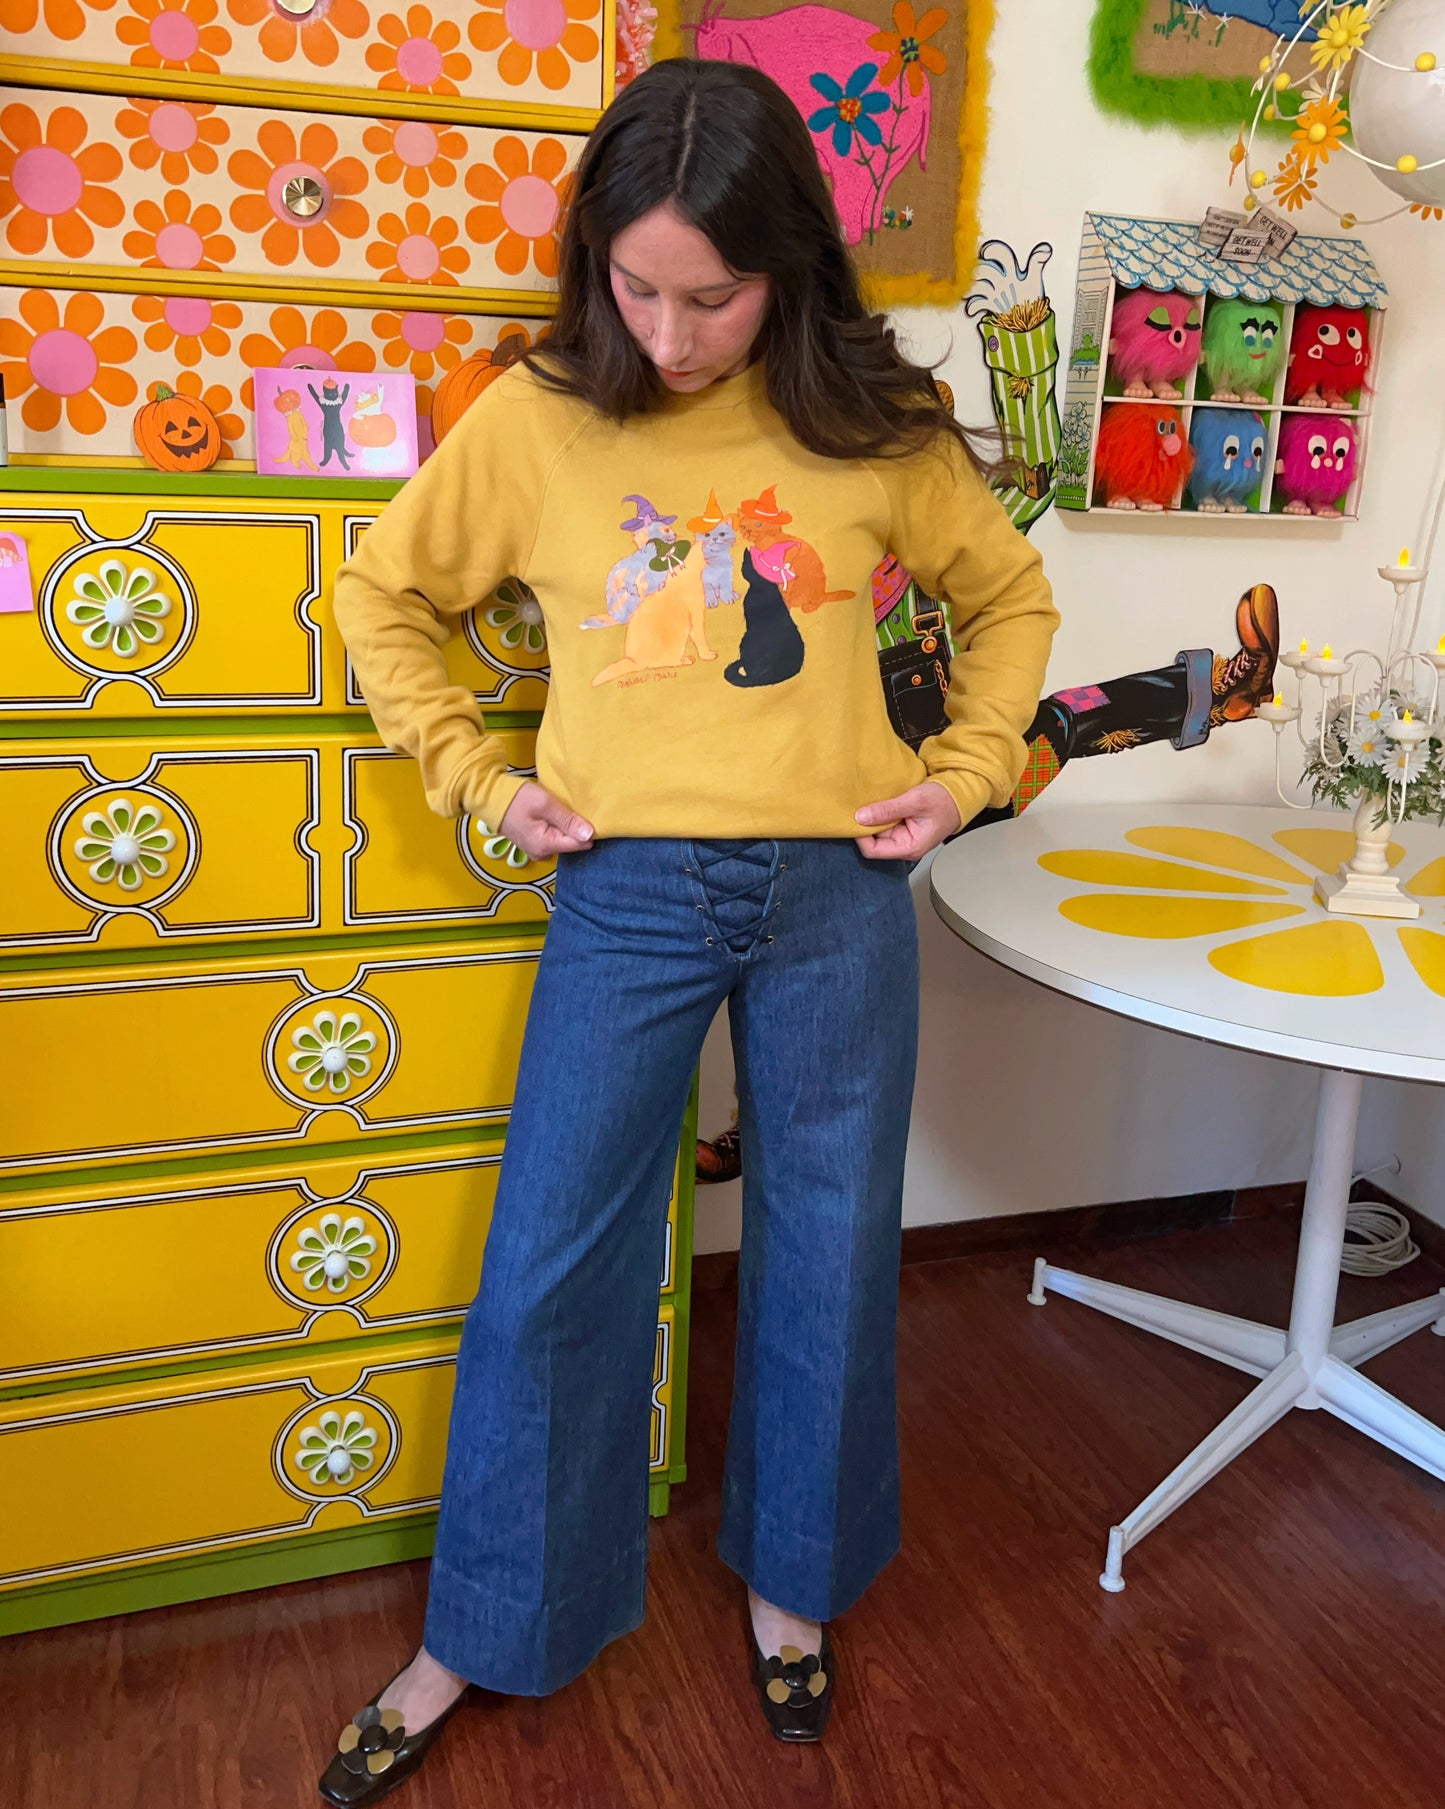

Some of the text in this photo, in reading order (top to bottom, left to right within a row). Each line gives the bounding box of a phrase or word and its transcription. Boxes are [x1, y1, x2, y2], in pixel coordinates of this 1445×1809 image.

[1260, 216, 1287, 240] GET WELL
[1233, 236, 1261, 246] GET WELL
[1233, 247, 1252, 256] SOON
